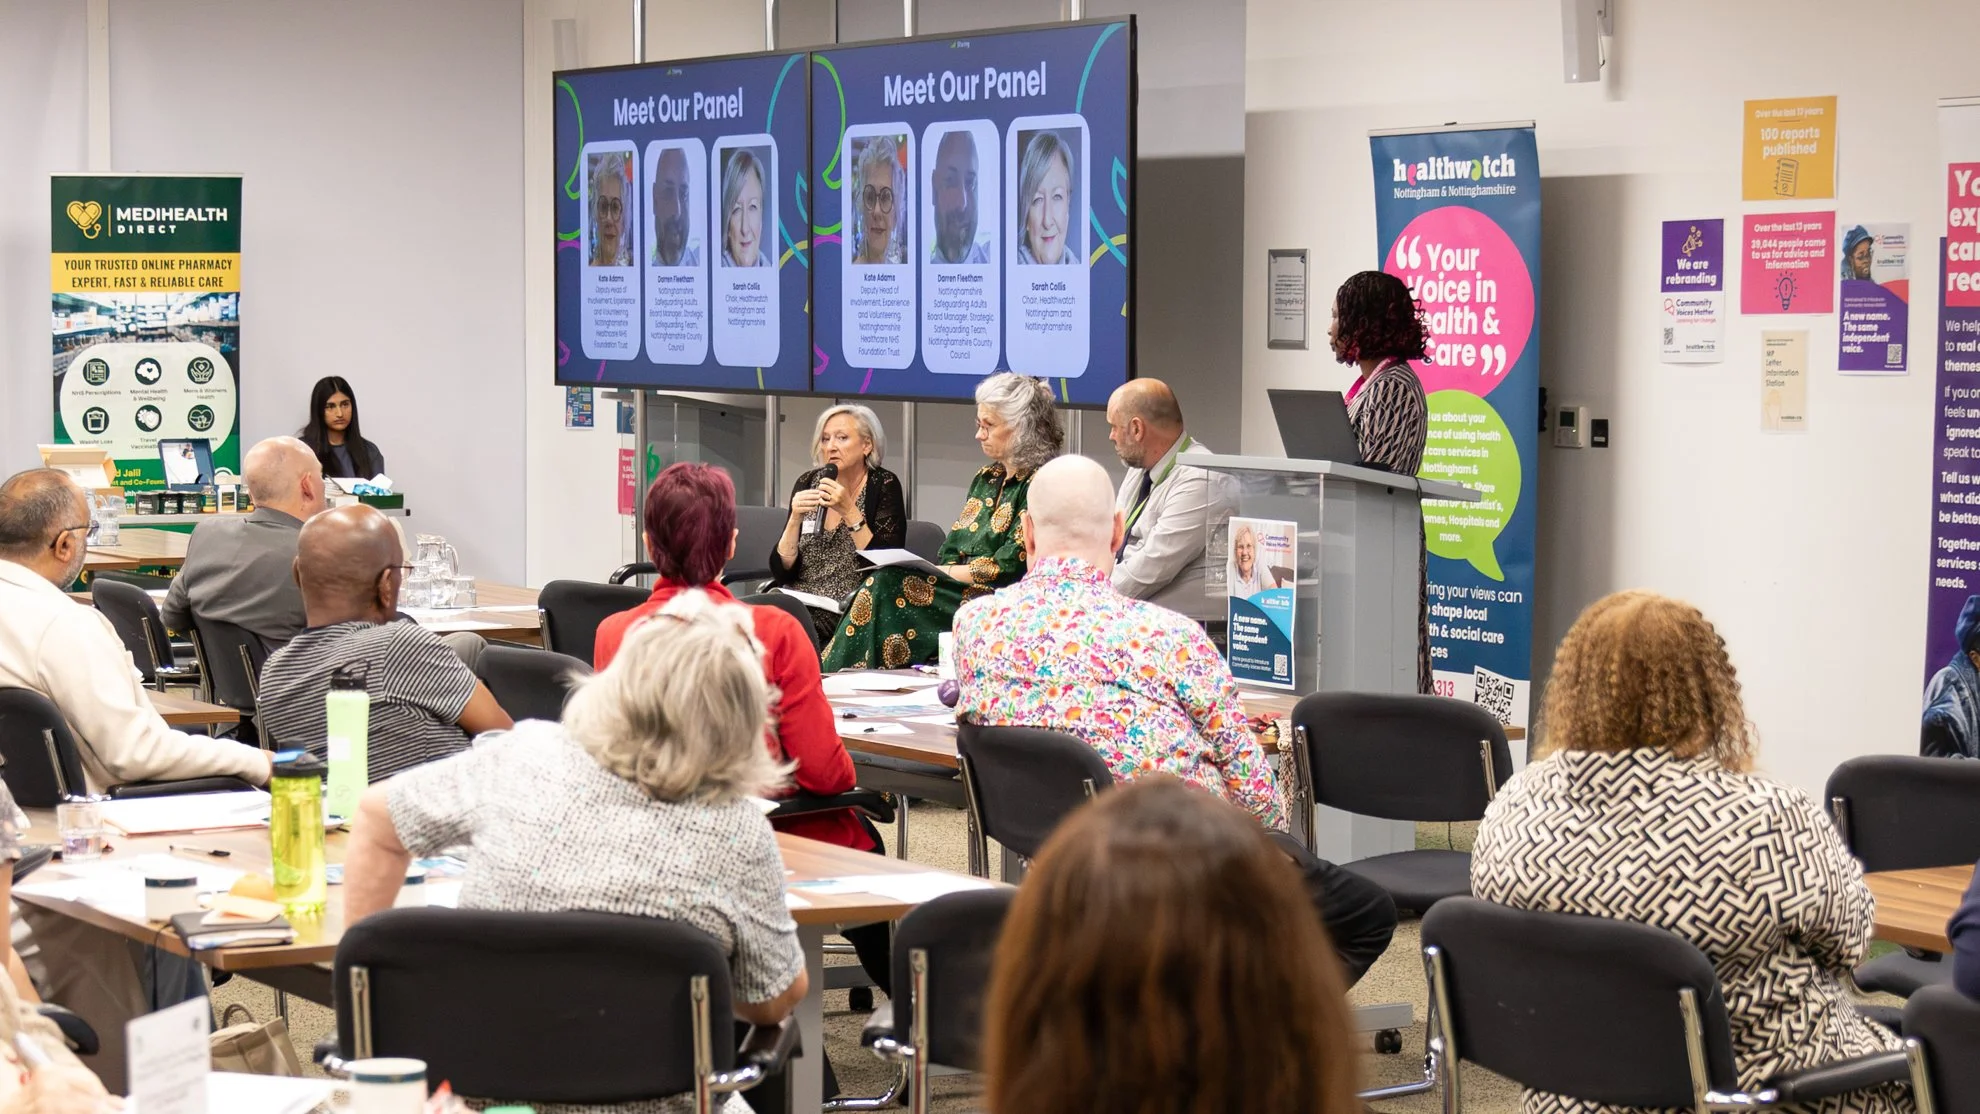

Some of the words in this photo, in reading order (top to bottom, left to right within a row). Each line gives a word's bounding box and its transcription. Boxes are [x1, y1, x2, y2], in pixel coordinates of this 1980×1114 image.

[884, 72, 935, 106] Meet
[940, 69, 980, 102] Our
[984, 62, 1046, 99] Panel
[614, 96, 655, 126] Meet
[658, 94, 690, 122] Our
[694, 87, 742, 120] Panel
[1761, 128, 1779, 140] 100
[1781, 127, 1820, 143] reports
[1763, 141, 1816, 159] published
[1393, 153, 1516, 186] healthwatch
[1394, 187, 1440, 200] Nottingham
[1441, 187, 1446, 196] &
[1449, 184, 1516, 198] Nottinghamshire
[117, 208, 228, 221] MEDIHEALTH
[118, 225, 176, 233] DIRECT
[1754, 224, 1771, 232] Over
[1772, 223, 1782, 231] the
[1783, 223, 1795, 231] last
[1803, 223, 1822, 232] years
[1779, 239, 1803, 250] people
[1805, 239, 1826, 247] came
[1426, 244, 1480, 271] Your
[1752, 251, 1760, 259] to
[1762, 251, 1770, 259] us
[1772, 250, 1783, 258] for
[1784, 249, 1808, 258] advice
[1810, 249, 1825, 257] and
[65, 260, 91, 270] YOUR
[95, 260, 138, 270] TRUSTED
[142, 259, 174, 269] ONLINE
[179, 259, 232, 269] PHARMACY
[1677, 259, 1691, 269] We
[1693, 261, 1708, 269] are
[1766, 260, 1809, 269] information
[72, 277, 111, 288] EXPERT,
[114, 277, 136, 287] FAST
[141, 278, 146, 287] &
[151, 277, 194, 287] RELIABLE
[198, 277, 223, 287] CARE
[938, 274, 956, 282] Darren
[957, 274, 983, 282] Fleetham
[1665, 272, 1716, 286] rebranding
[860, 286, 878, 295] Deputy
[1032, 282, 1048, 290] Sarah
[1050, 282, 1066, 290] Collis
[1407, 271, 1471, 303] Voice
[1476, 271, 1496, 303] in
[1676, 299, 1712, 308] Community
[1483, 306, 1500, 335] &
[1844, 311, 1850, 320] A
[1843, 322, 1857, 332] The
[1858, 324, 1878, 332] same
[1945, 320, 1960, 332] We
[1842, 333, 1890, 344] independent
[1842, 344, 1864, 353] voice.
[1945, 341, 1955, 351] to
[1957, 340, 1976, 351] real
[950, 351, 970, 359] Council
[1945, 385, 1951, 397] If
[1952, 389, 1969, 401] you
[1944, 405, 1966, 418] feels
[1432, 414, 1441, 422] us
[1442, 412, 1467, 423] about
[1468, 414, 1486, 426] your
[1444, 430, 1452, 438] of
[1453, 432, 1476, 443] using
[1477, 431, 1501, 441] health
[1429, 448, 1446, 456] care
[1448, 447, 1481, 457] services
[1482, 447, 1488, 458] in
[1944, 446, 1969, 461] speak
[1423, 462, 1472, 476] Nottingham
[1473, 465, 1478, 475] &
[1941, 472, 1958, 483] Tell
[1959, 474, 1970, 484] us
[1475, 482, 1495, 493] Share
[1940, 491, 1964, 503] what
[1939, 510, 1951, 522] be
[1449, 516, 1484, 531] Hospitals
[1485, 518, 1500, 528] and
[1440, 533, 1462, 542] more.
[1937, 556, 1977, 570] services
[1935, 577, 1968, 589] needs.
[1447, 586, 1468, 600] your
[1470, 586, 1496, 601] views
[1498, 591, 1522, 603] can
[1233, 613, 1238, 621] A
[1432, 603, 1462, 622] shape
[1464, 605, 1487, 621] local
[1233, 623, 1243, 631] The
[1244, 626, 1259, 634] same
[1441, 624, 1448, 638] &
[1450, 626, 1480, 641] social
[1482, 631, 1504, 644] care
[1233, 632, 1268, 644] independent
